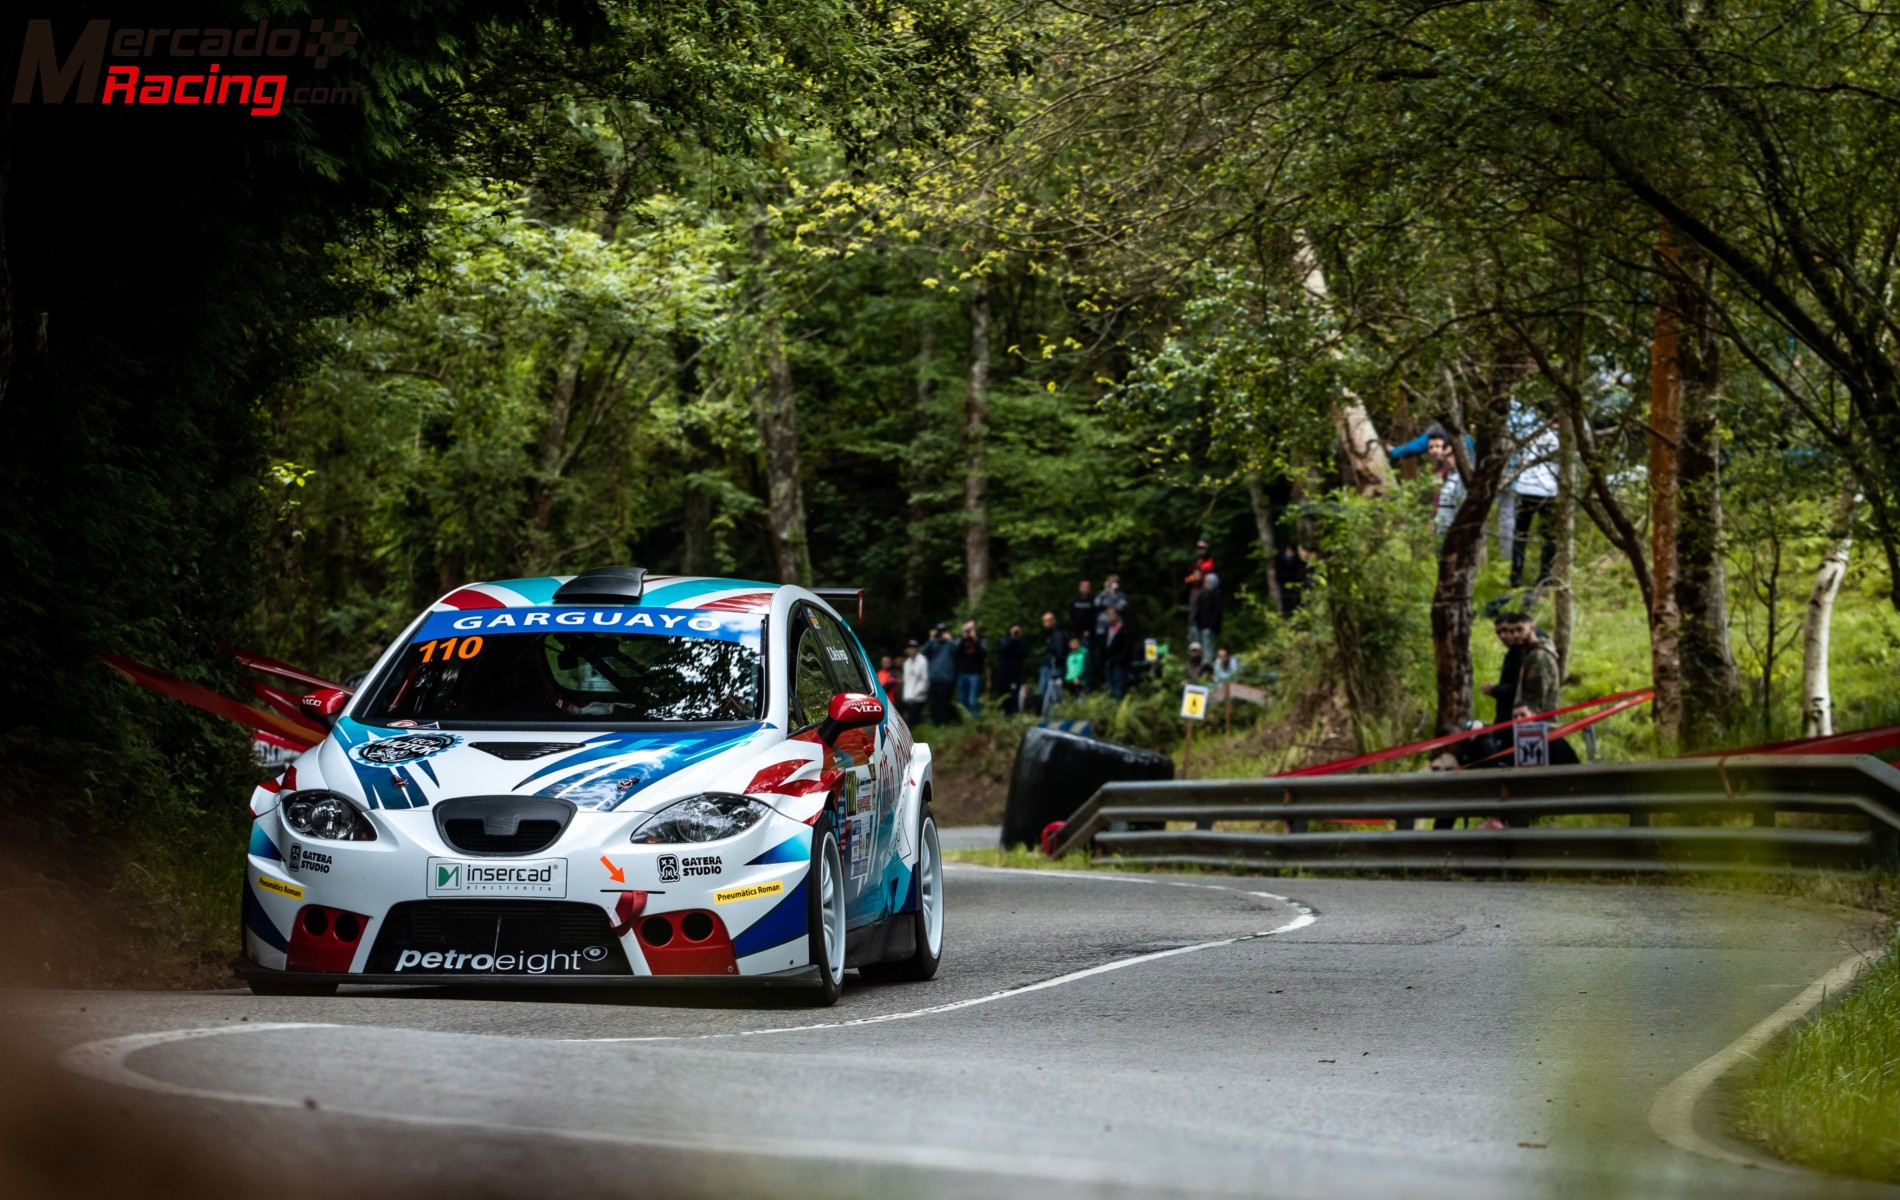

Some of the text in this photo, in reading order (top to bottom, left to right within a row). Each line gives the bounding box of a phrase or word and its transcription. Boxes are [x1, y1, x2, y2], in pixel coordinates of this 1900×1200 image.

[452, 611, 722, 632] GARGUAYO
[419, 635, 484, 663] 110
[302, 850, 332, 865] GATERA
[681, 856, 722, 867] GATERA
[301, 860, 330, 874] STUDIO
[682, 865, 722, 877] STUDIO
[757, 884, 781, 895] Roman
[395, 949, 581, 974] petroeight
